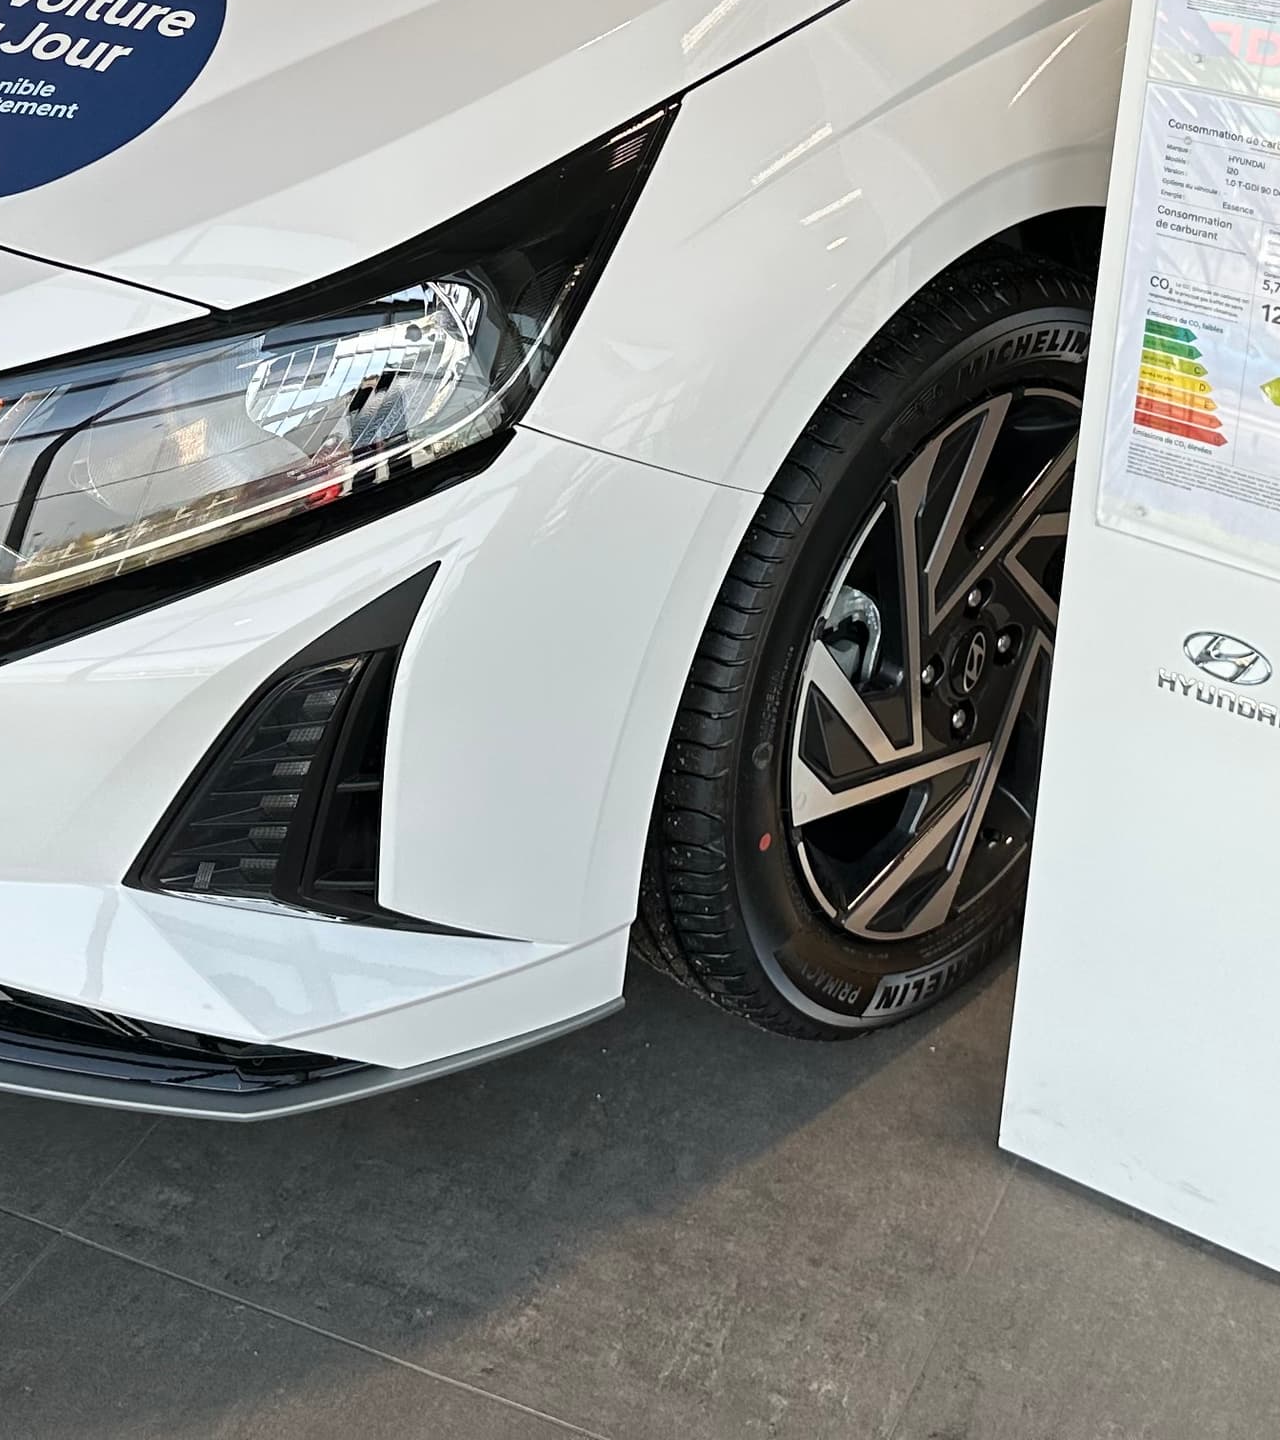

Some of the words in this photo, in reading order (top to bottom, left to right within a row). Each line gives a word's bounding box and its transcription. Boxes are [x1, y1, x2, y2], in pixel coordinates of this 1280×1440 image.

[0, 22, 134, 73] Jour
[1168, 119, 1244, 143] Consommation
[1246, 136, 1259, 147] de
[1228, 155, 1266, 170] HYUNDAI
[1261, 184, 1271, 194] 90
[1222, 201, 1254, 215] Essence
[1157, 205, 1233, 230] Consommation
[1156, 219, 1168, 229] de
[1170, 221, 1218, 241] carburant
[1193, 366, 1201, 375] C
[1199, 383, 1206, 392] D
